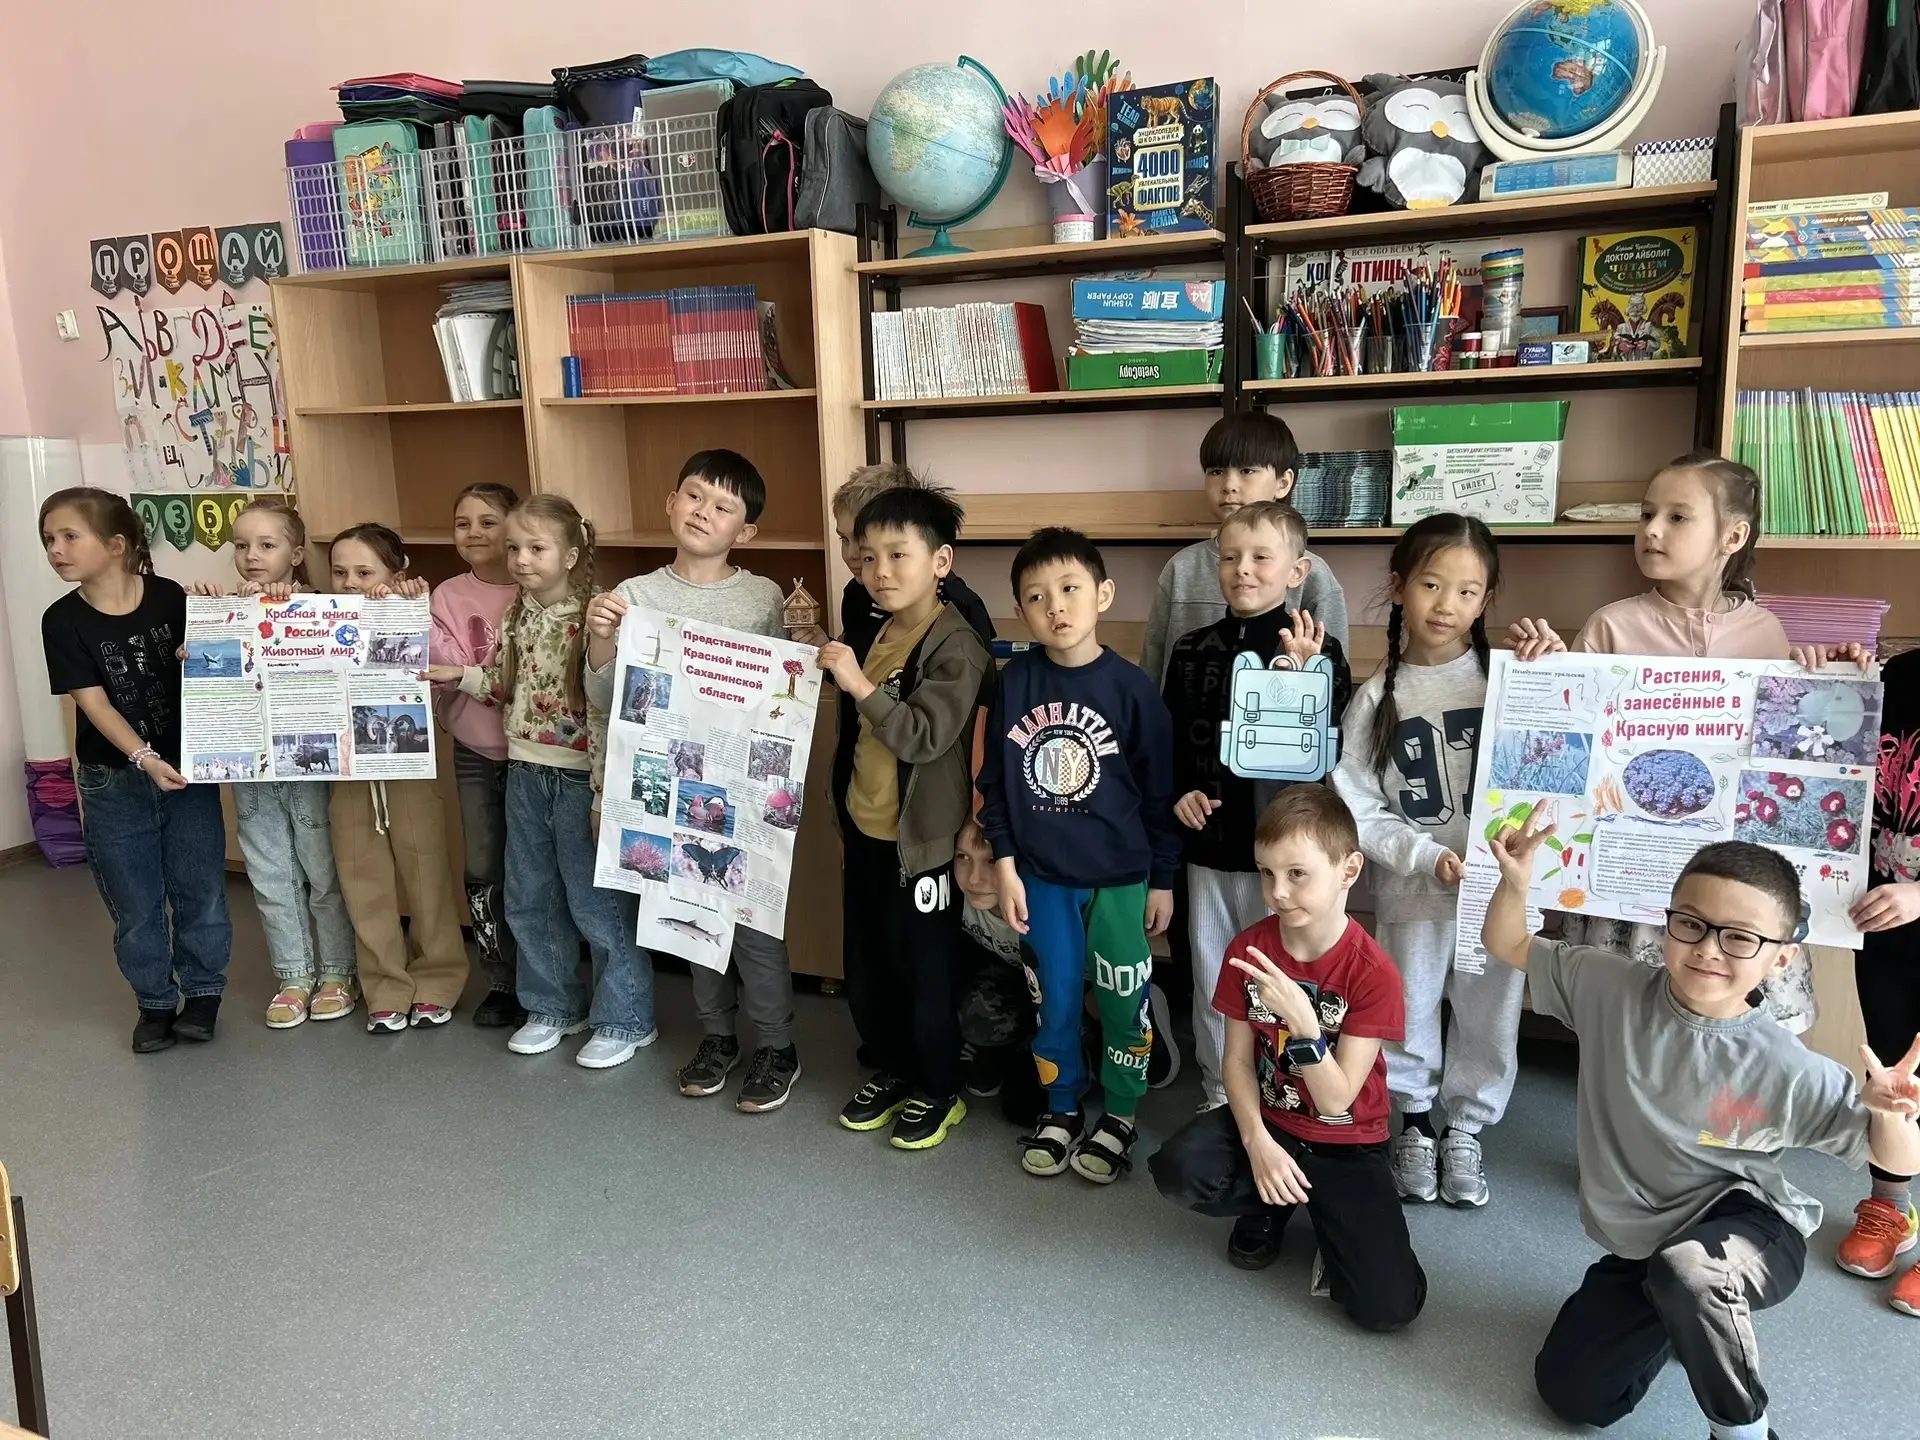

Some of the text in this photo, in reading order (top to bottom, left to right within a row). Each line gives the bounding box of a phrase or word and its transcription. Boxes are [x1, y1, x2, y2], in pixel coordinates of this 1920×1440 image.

[1119, 101, 1141, 123] ТЕЛО
[1138, 126, 1180, 138] ЭНЦИКЛОПЕДИЯ
[1138, 133, 1180, 144] ШКОЛЬНИКА
[1137, 148, 1180, 179] 4000
[1138, 177, 1180, 188] УВЛЕКАТЕЛЬНЫХ
[1137, 185, 1180, 206] ФАКТОВ
[1150, 215, 1179, 229] ЗЕМЛЯ
[1369, 246, 1389, 256] ОБО
[1604, 248, 1672, 264] ДОКТОР АЙБОЛИТ
[1609, 259, 1668, 273] ЧИТАЕМ
[1617, 269, 1658, 281] САМИ
[1086, 292, 1134, 300] COPY PAPER
[1103, 299, 1126, 308] SHUN
[1190, 290, 1210, 303] A4
[1523, 346, 1547, 354] ГУАШЬ
[1118, 363, 1161, 380] SvetoCopy
[1460, 478, 1487, 491] БИЛЕТ
[1404, 490, 1444, 501] ТОПЕ
[265, 607, 359, 622] Красная книга
[284, 625, 335, 638] России.
[261, 644, 360, 658] Животный мир.
[683, 630, 772, 657] Представители
[683, 646, 770, 674] Красной книги
[685, 664, 763, 691] Сахалинской
[1642, 667, 1726, 685] Растения,
[699, 685, 745, 704] области
[1624, 692, 1741, 711] занесённые в
[1007, 701, 1120, 758] MANHATTAN
[1615, 720, 1749, 741] Красную книгу.
[1039, 745, 1088, 787] NY
[914, 870, 951, 914] ON
